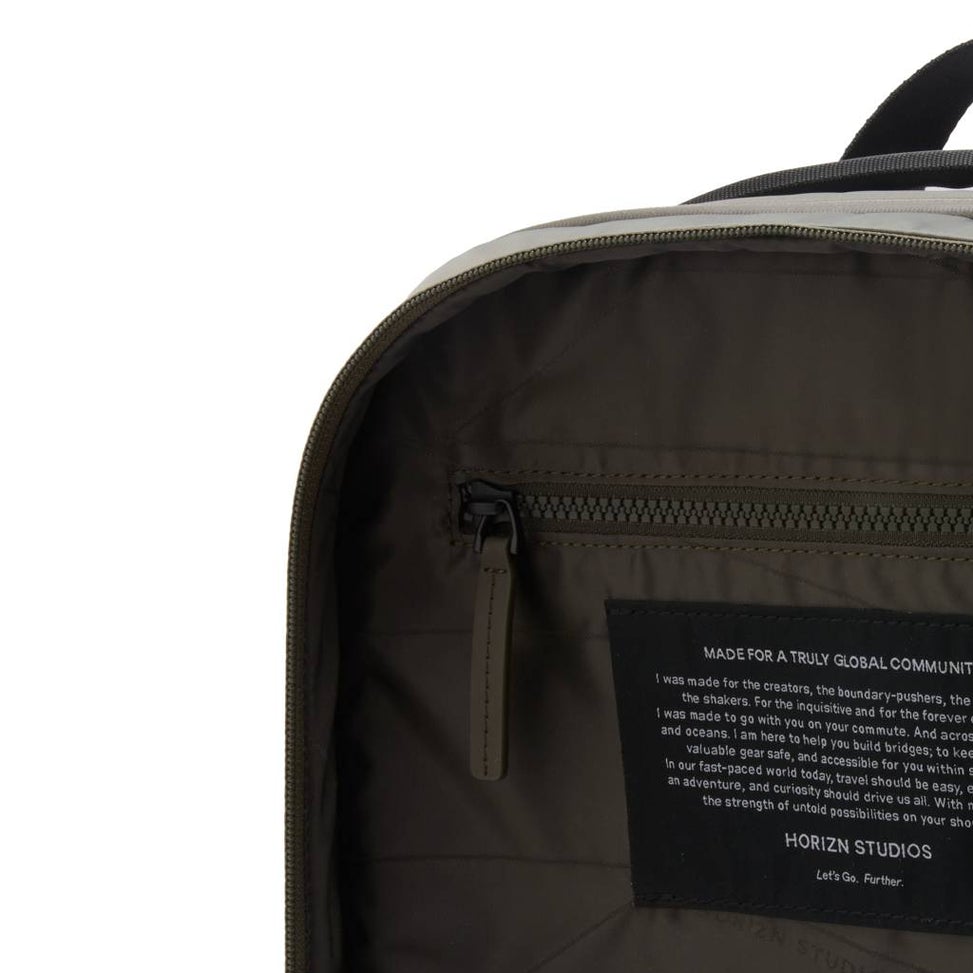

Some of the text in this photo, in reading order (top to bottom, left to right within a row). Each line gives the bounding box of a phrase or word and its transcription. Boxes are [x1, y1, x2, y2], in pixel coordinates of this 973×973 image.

[703, 646, 746, 661] MADE
[747, 647, 774, 663] FOR
[776, 649, 788, 663] A
[789, 650, 830, 666] TRULY
[833, 653, 888, 670] GLOBAL
[655, 673, 660, 683] I
[662, 676, 685, 686] was
[687, 676, 720, 688] made
[722, 677, 740, 689] for
[742, 679, 761, 691] the
[763, 682, 813, 697] creators,
[815, 684, 836, 697] the
[837, 685, 947, 707] boundary-pushers,
[949, 694, 971, 707] the
[656, 707, 661, 718] I
[663, 710, 686, 720] was
[689, 710, 721, 722] made
[724, 712, 737, 723] to
[739, 714, 755, 727] go
[757, 713, 782, 726] with
[784, 718, 805, 730] you
[807, 720, 822, 730] on
[824, 721, 850, 734] your
[851, 724, 910, 737] commute.
[913, 725, 937, 740] And
[681, 692, 700, 704] the
[702, 693, 751, 707] shakers.
[754, 695, 772, 708] For
[774, 698, 793, 710] the
[796, 699, 853, 716] inquisitive
[854, 706, 876, 718] and
[878, 706, 898, 719] for
[899, 708, 920, 721] the
[921, 709, 968, 724] forever
[660, 724, 681, 736] and
[685, 727, 731, 739] oceans.
[733, 728, 737, 739] I
[740, 730, 758, 741] am
[760, 730, 786, 743] here
[788, 732, 801, 745] to
[802, 733, 827, 749] help
[830, 738, 850, 751] you
[852, 738, 882, 753] build
[884, 741, 934, 759] bridges;
[935, 746, 949, 758] to
[686, 743, 736, 757] valuable
[739, 748, 765, 760] gear
[767, 748, 795, 763] safe,
[797, 751, 818, 763] and
[820, 755, 879, 769] accessible
[881, 758, 899, 770] for
[902, 761, 924, 774] you
[926, 762, 965, 775] within
[665, 757, 675, 769] In
[678, 761, 697, 771] our
[698, 760, 763, 776] fast-paced
[765, 766, 797, 778] world
[800, 768, 834, 785] today,
[835, 772, 869, 786] travel
[870, 775, 912, 789] should
[914, 777, 929, 791] be
[932, 782, 964, 796] easy,
[667, 776, 681, 785] an
[683, 776, 746, 793] adventure,
[748, 781, 770, 793] and
[773, 782, 821, 800] curiosity
[823, 787, 860, 802] should
[863, 791, 894, 804] drive
[896, 795, 911, 805] us
[913, 795, 930, 807] all.
[933, 796, 964, 810] With
[702, 795, 722, 807] the
[724, 797, 775, 812] strength
[777, 799, 790, 811] of
[792, 802, 827, 815] untold
[830, 807, 900, 822] possibilities
[902, 813, 917, 822] on
[920, 814, 946, 826] your
[784, 832, 933, 860] HORIZN STUDIOS
[841, 871, 859, 884] Go.
[863, 873, 904, 887] Further.
